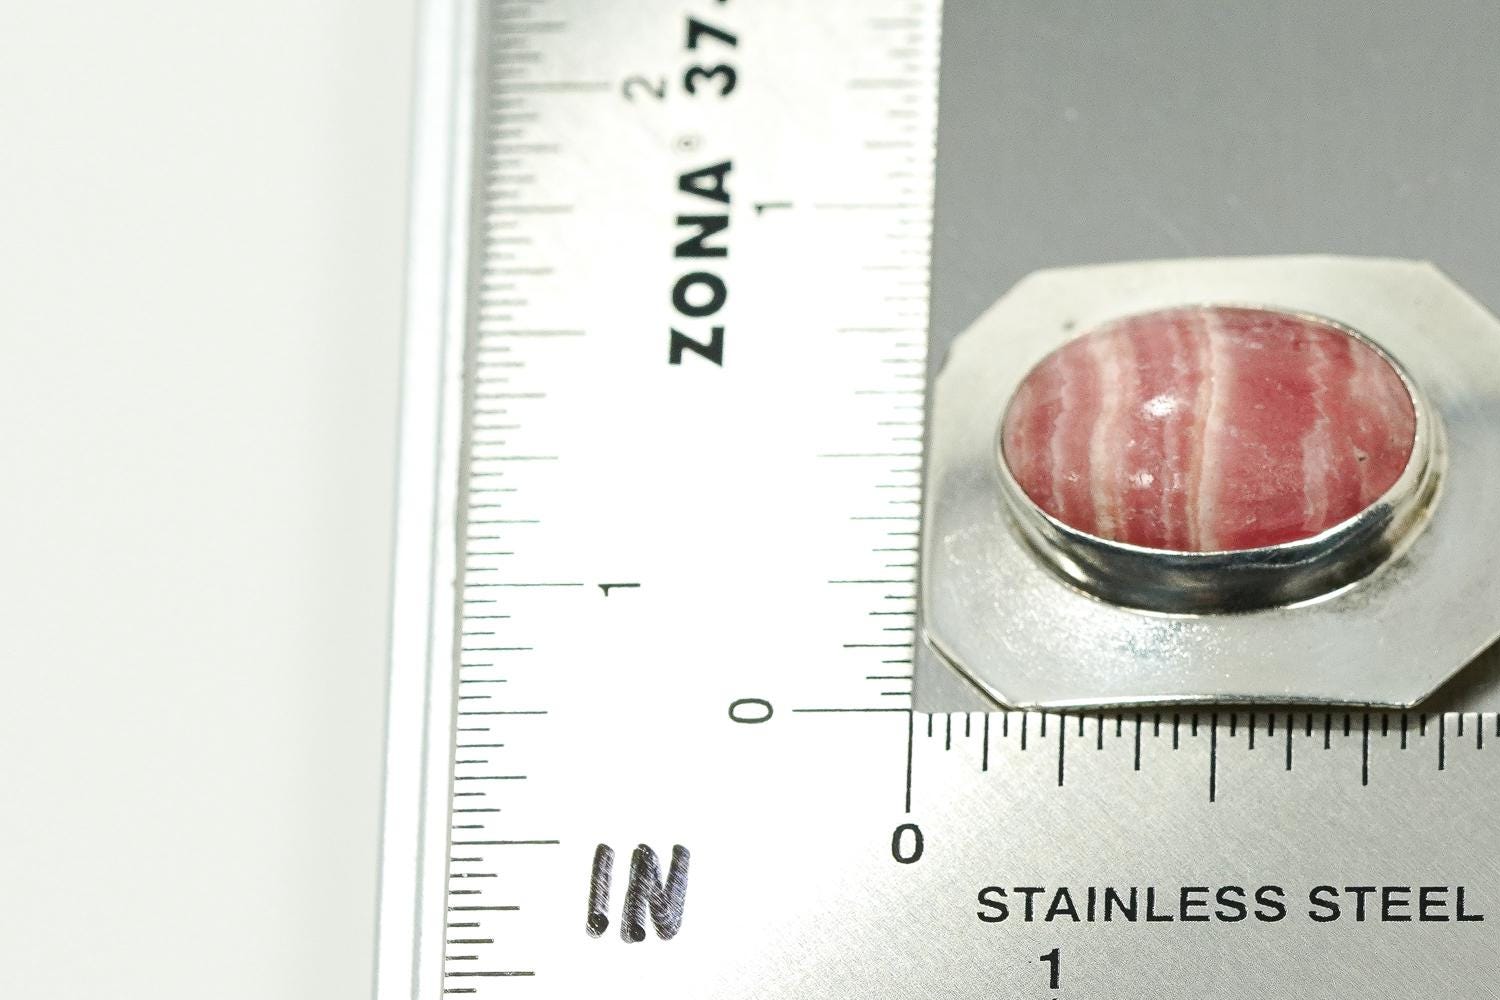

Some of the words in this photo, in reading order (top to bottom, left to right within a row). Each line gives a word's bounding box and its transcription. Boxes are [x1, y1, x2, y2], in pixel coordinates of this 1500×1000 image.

[684, 0, 737, 97] 37
[621, 73, 668, 102] 2
[753, 200, 793, 217] 1
[669, 160, 733, 367] ZONA
[597, 582, 641, 597] 1
[728, 698, 774, 724] 0
[891, 823, 925, 865] 0
[585, 842, 691, 945] IN
[976, 885, 1287, 924] STAINLESS
[1307, 885, 1485, 923] STEEL
[1039, 947, 1062, 990] 1
